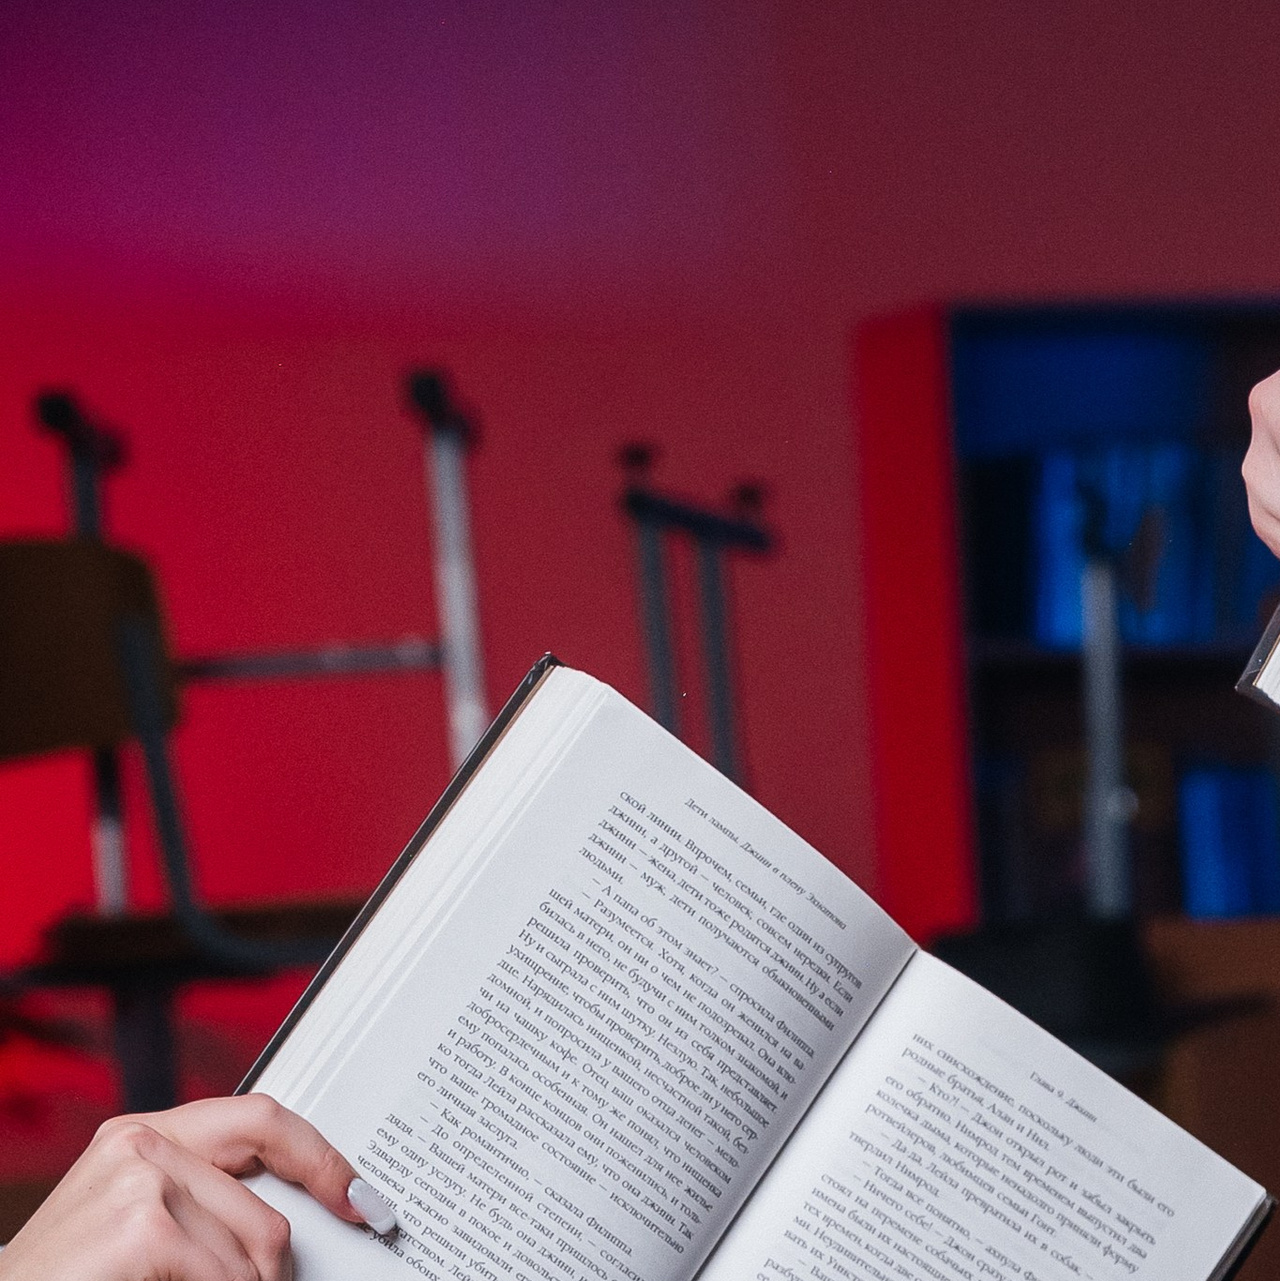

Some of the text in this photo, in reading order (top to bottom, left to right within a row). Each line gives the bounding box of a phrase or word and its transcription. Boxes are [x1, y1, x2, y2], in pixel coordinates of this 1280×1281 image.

[683, 797, 709, 819] Дети
[738, 841, 773, 869] Джинн
[771, 866, 780, 874] в
[778, 871, 806, 895] плену
[517, 927, 537, 947] Ну
[534, 942, 545, 954] и
[544, 950, 589, 987] сыграла
[588, 983, 598, 993] с
[596, 988, 621, 1011] ним
[416, 1070, 436, 1087] его
[435, 1085, 477, 1118] личная
